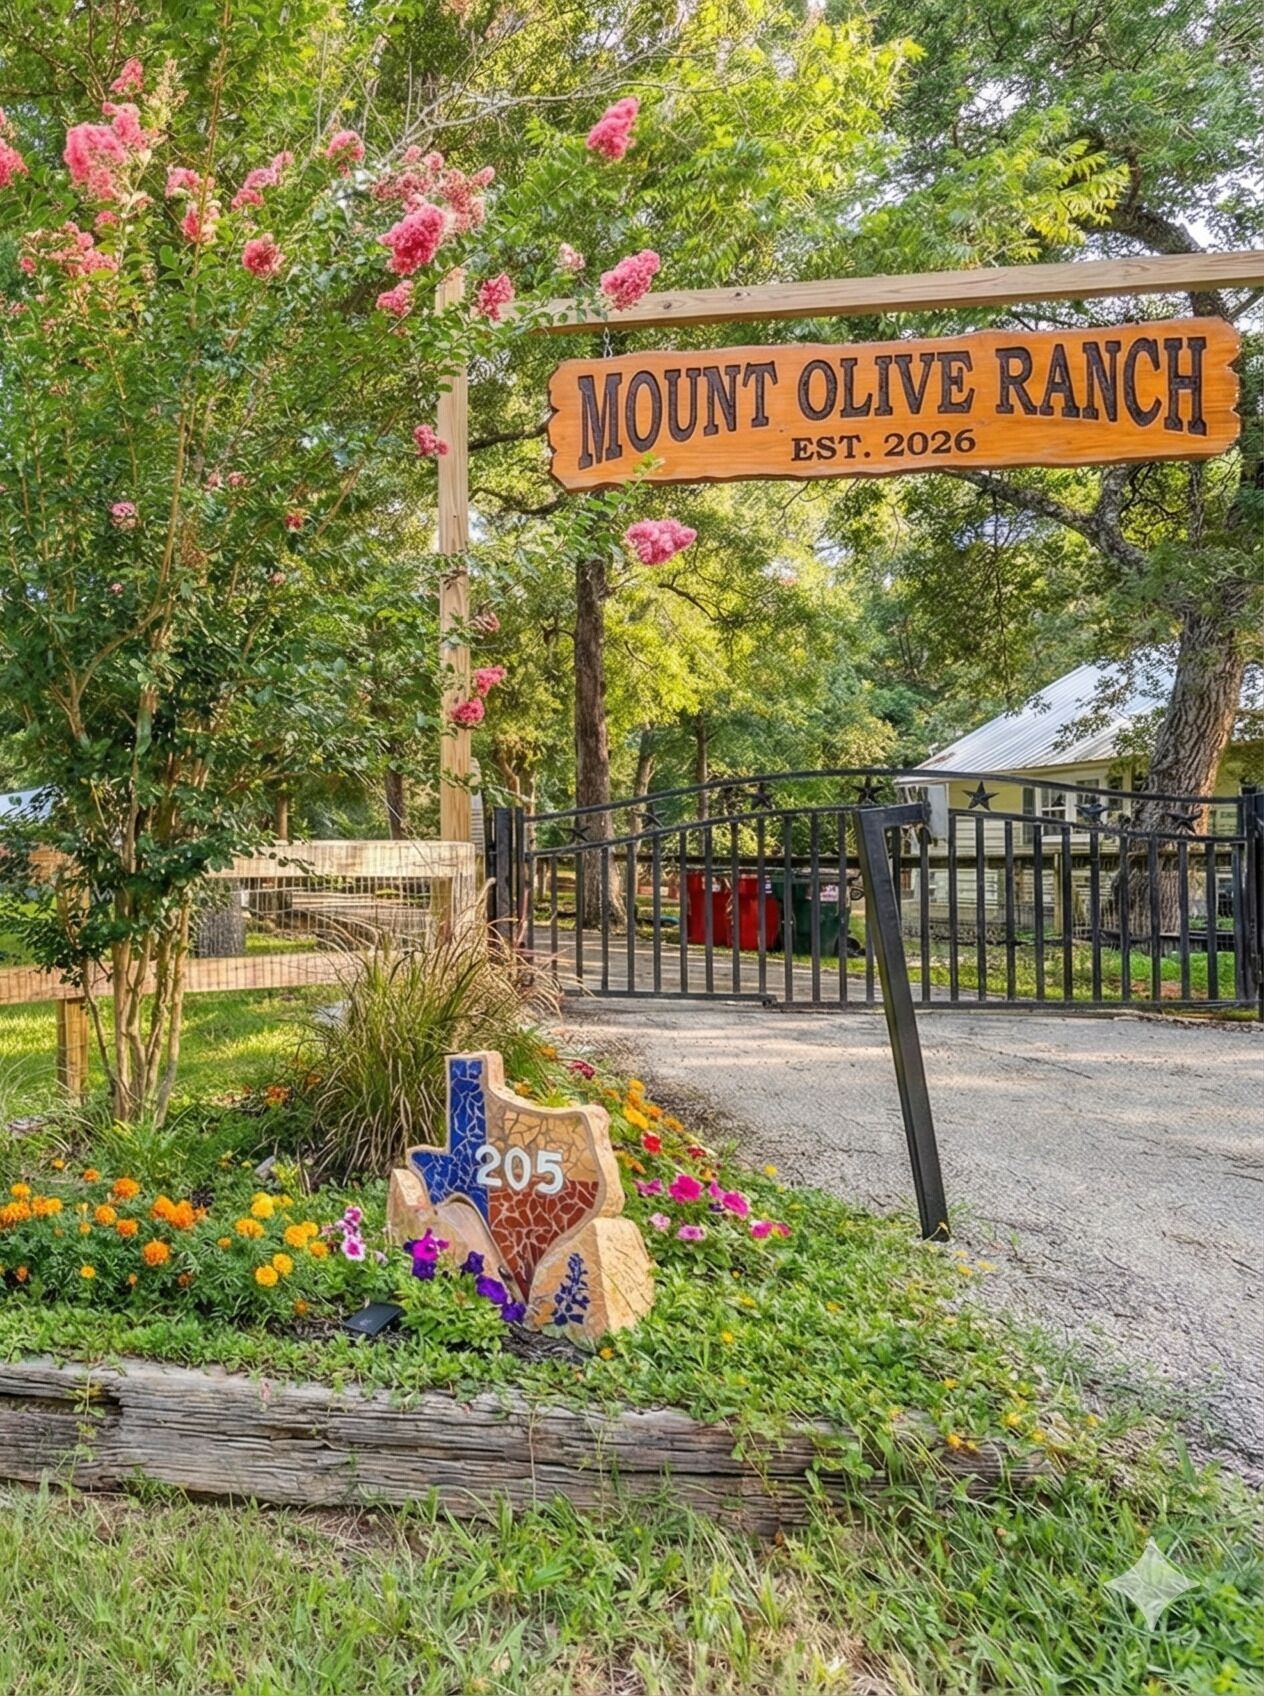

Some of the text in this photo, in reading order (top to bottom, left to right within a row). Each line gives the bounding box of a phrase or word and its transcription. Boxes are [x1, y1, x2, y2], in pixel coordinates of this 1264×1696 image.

[577, 336, 1209, 470] MOUNT OLIVE RANCH
[791, 428, 976, 462] EST. 2026
[475, 1145, 565, 1195] 205
